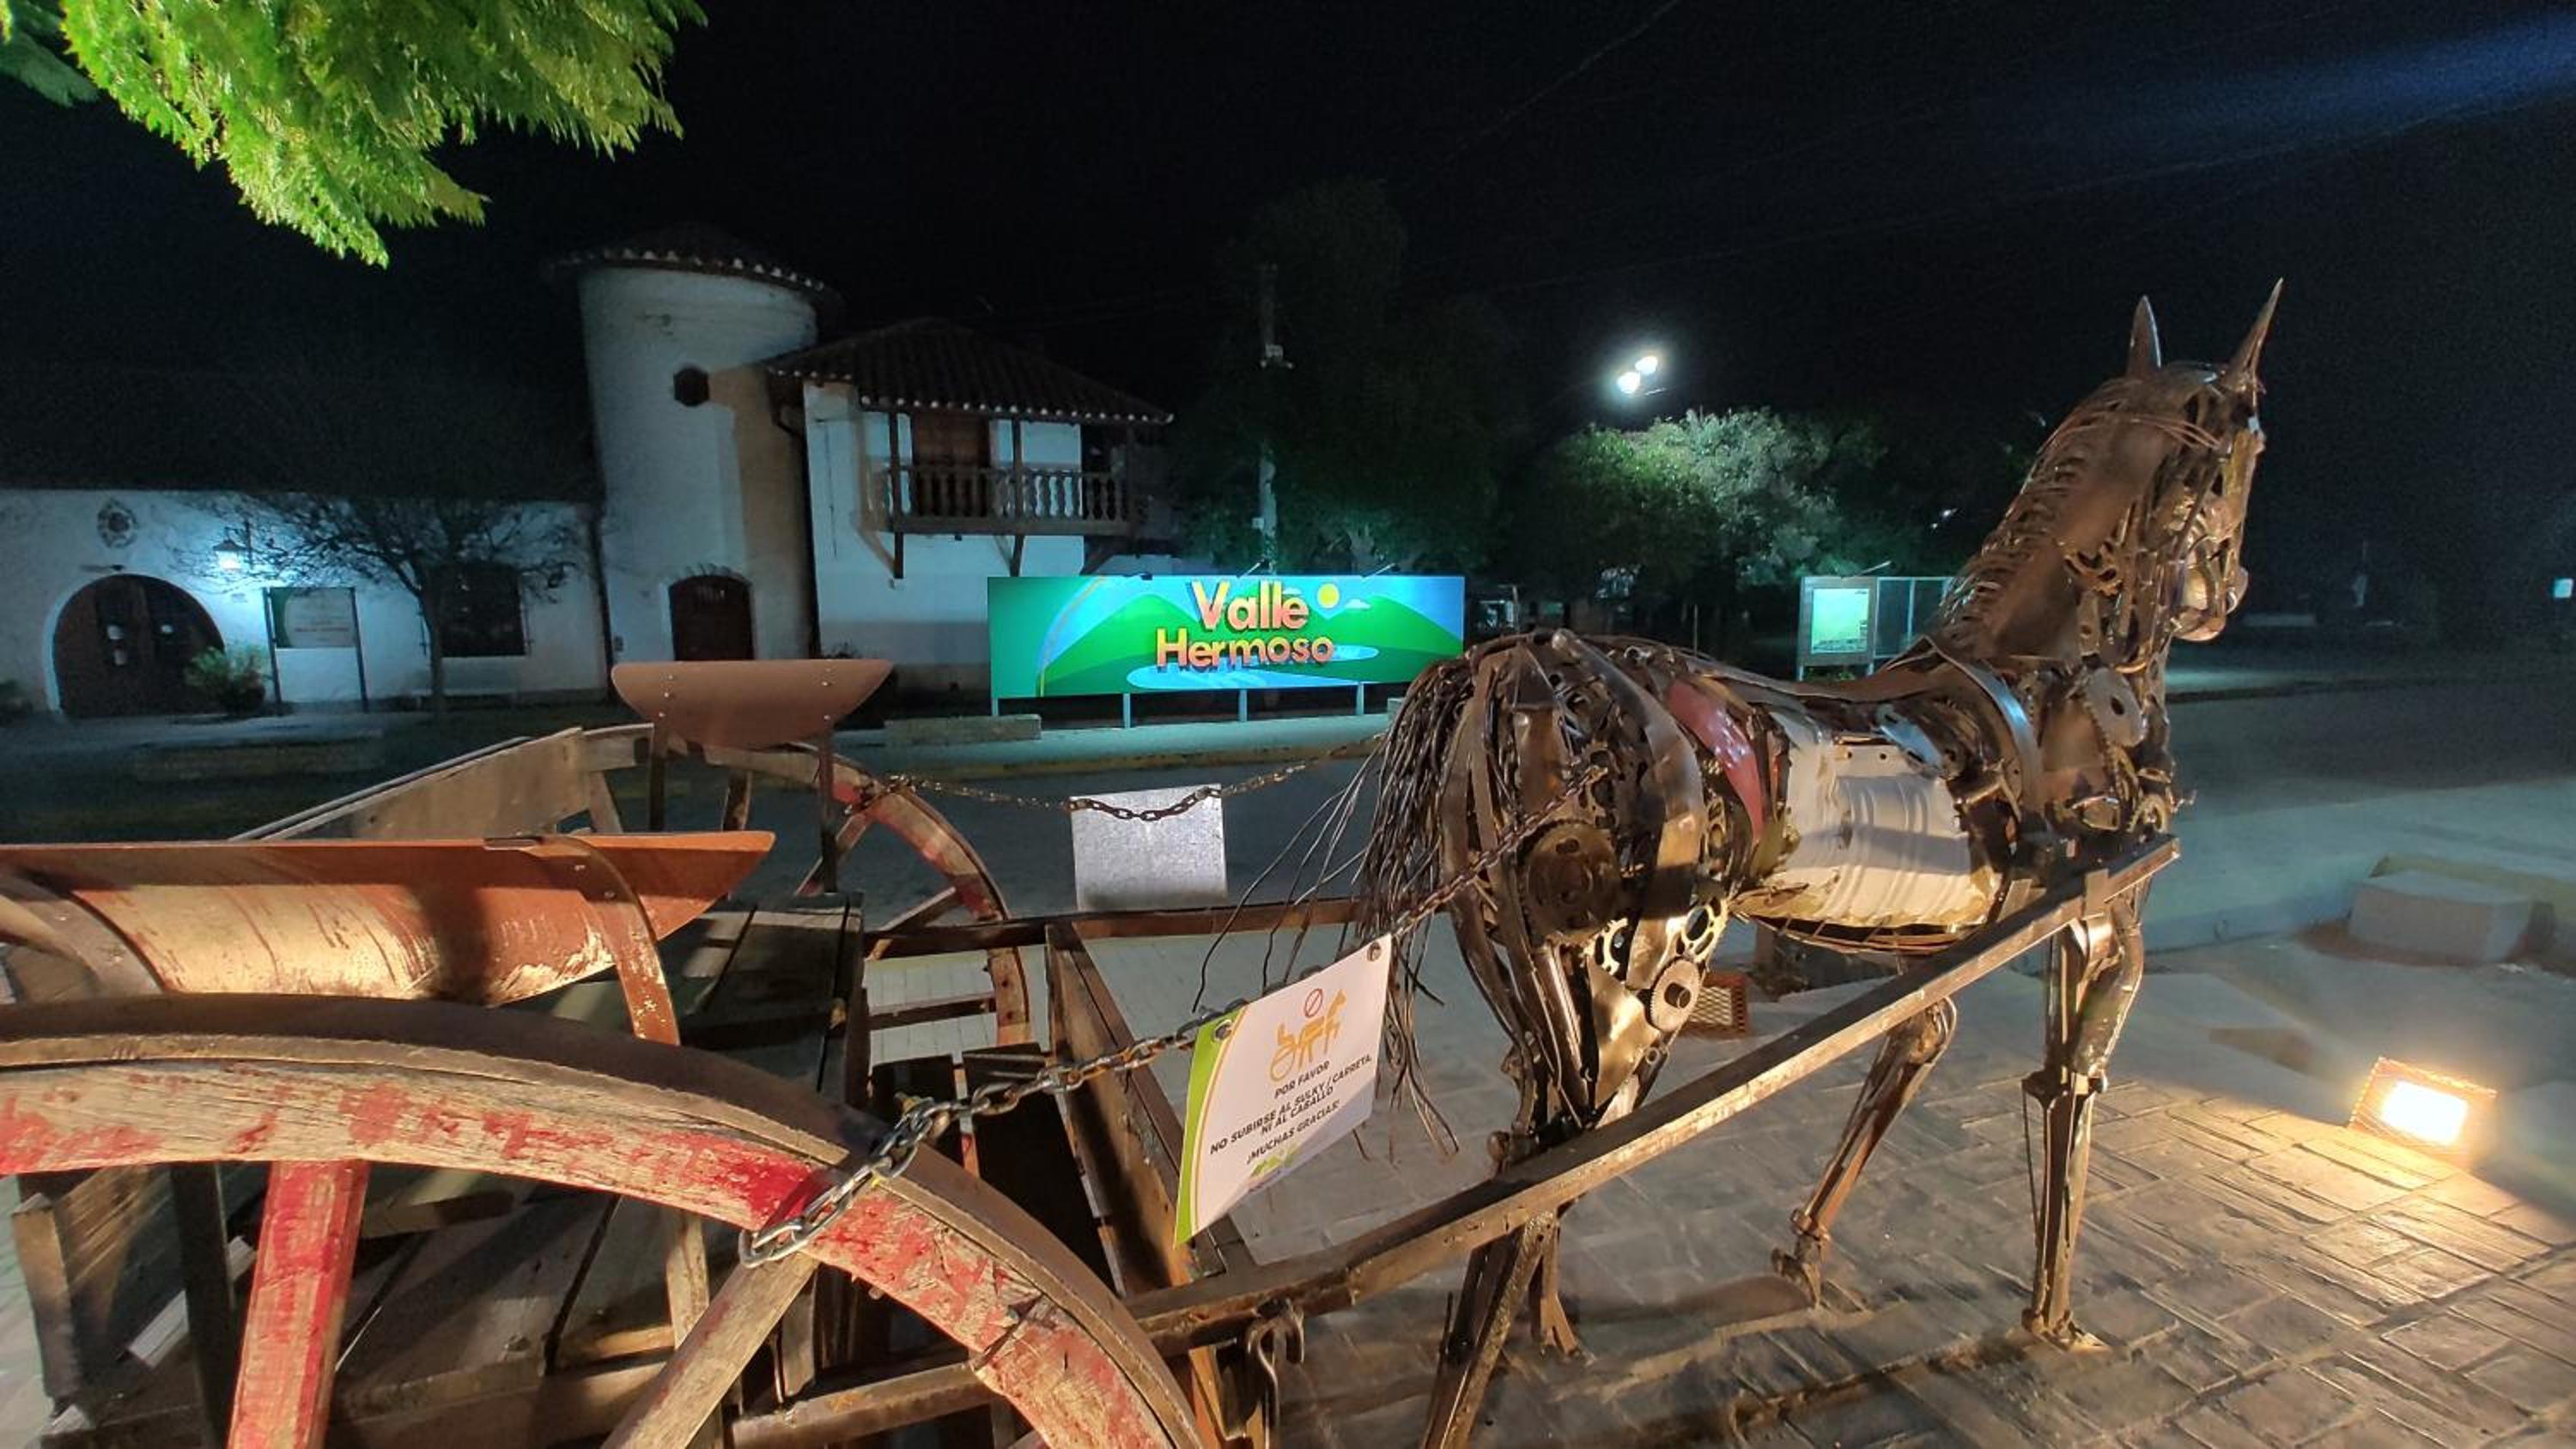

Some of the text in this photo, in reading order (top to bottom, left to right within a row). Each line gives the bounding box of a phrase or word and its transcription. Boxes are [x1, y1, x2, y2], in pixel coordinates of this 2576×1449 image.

[1190, 579, 1309, 631] Valle
[1156, 627, 1334, 669] Hermoso
[1210, 1137, 1228, 1155] NO
[1230, 1109, 1277, 1143] SUBIRSE
[1279, 1101, 1292, 1115] AL
[1294, 1082, 1326, 1107] SULKY
[1332, 1053, 1372, 1083] CARRETA
[1273, 1060, 1330, 1099] POR FAVOR
[1261, 1086, 1334, 1136] NI AL CABALLO
